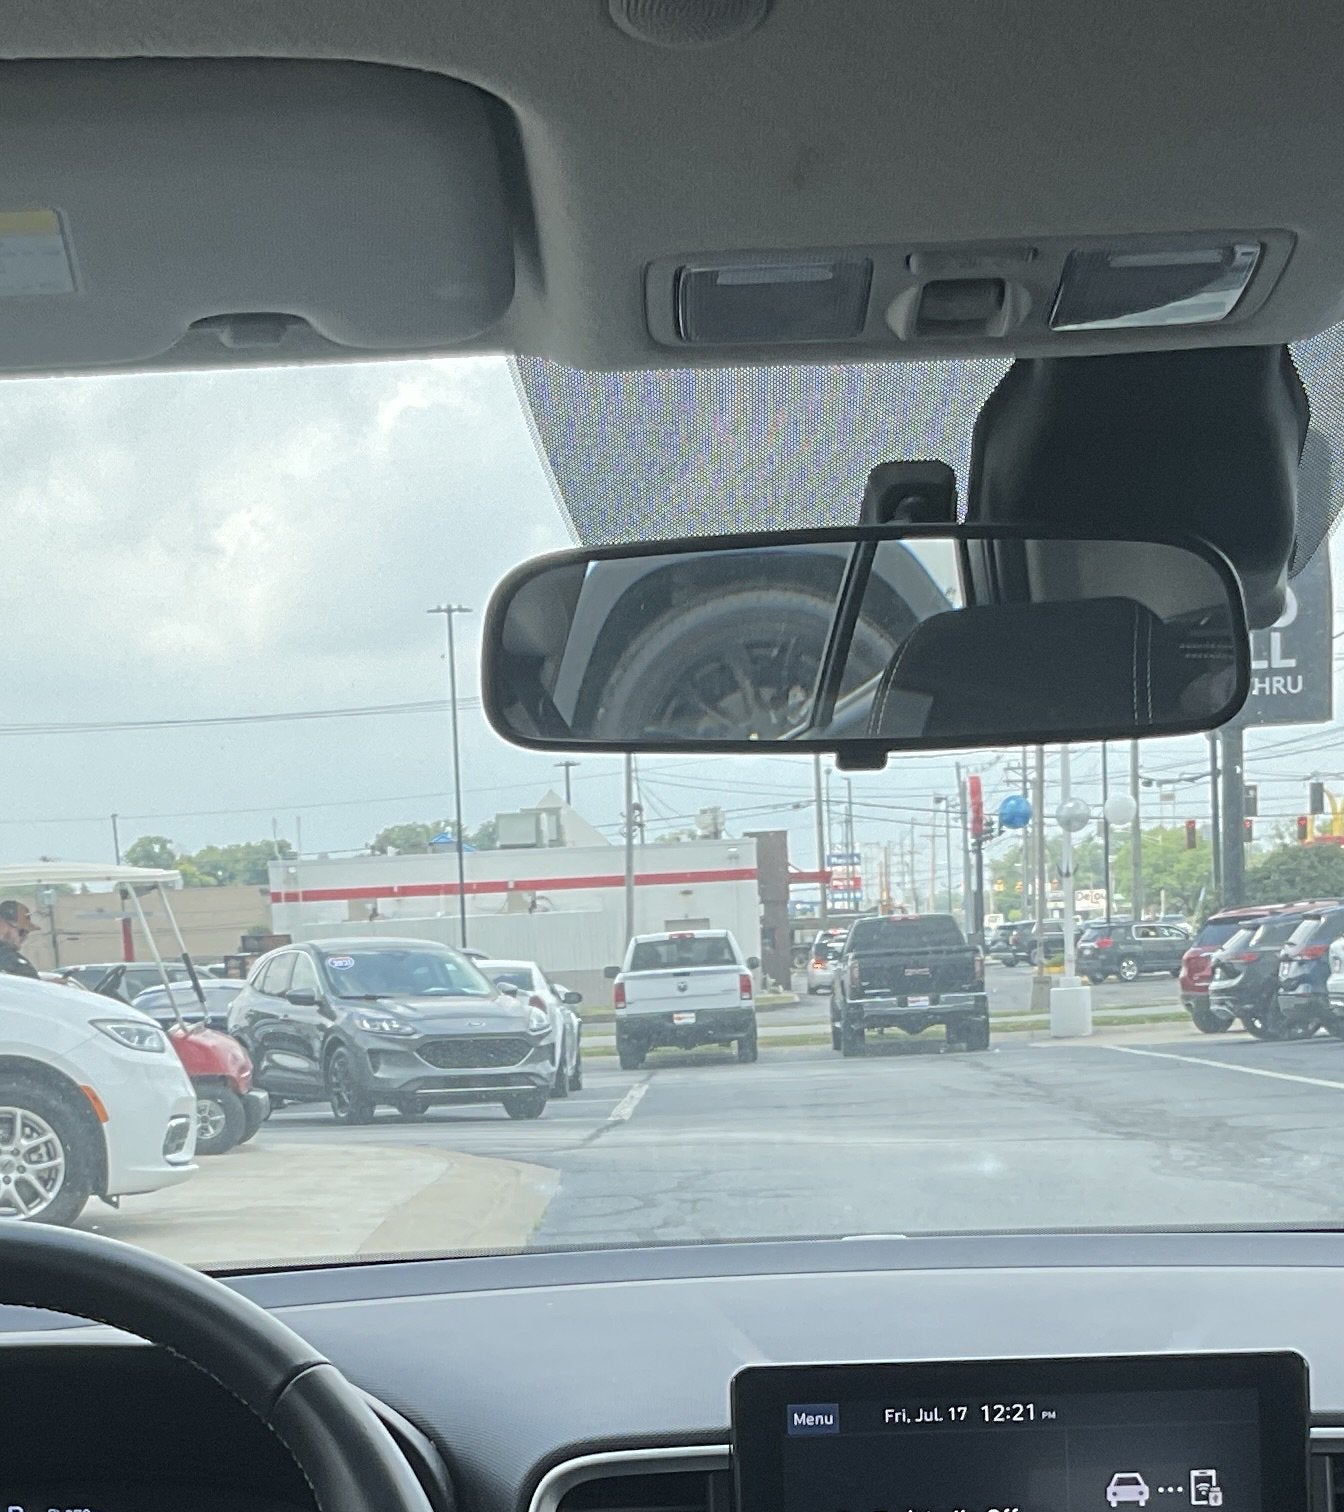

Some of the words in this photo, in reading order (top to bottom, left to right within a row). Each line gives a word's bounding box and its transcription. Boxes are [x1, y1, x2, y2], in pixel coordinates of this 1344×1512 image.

[1250, 675, 1303, 695] HRU
[793, 1412, 834, 1427] Menu
[914, 1407, 944, 1423] Jul.
[948, 1406, 968, 1421] 17
[980, 1403, 1035, 1422] 12:21
[1040, 1411, 1057, 1420] PM
